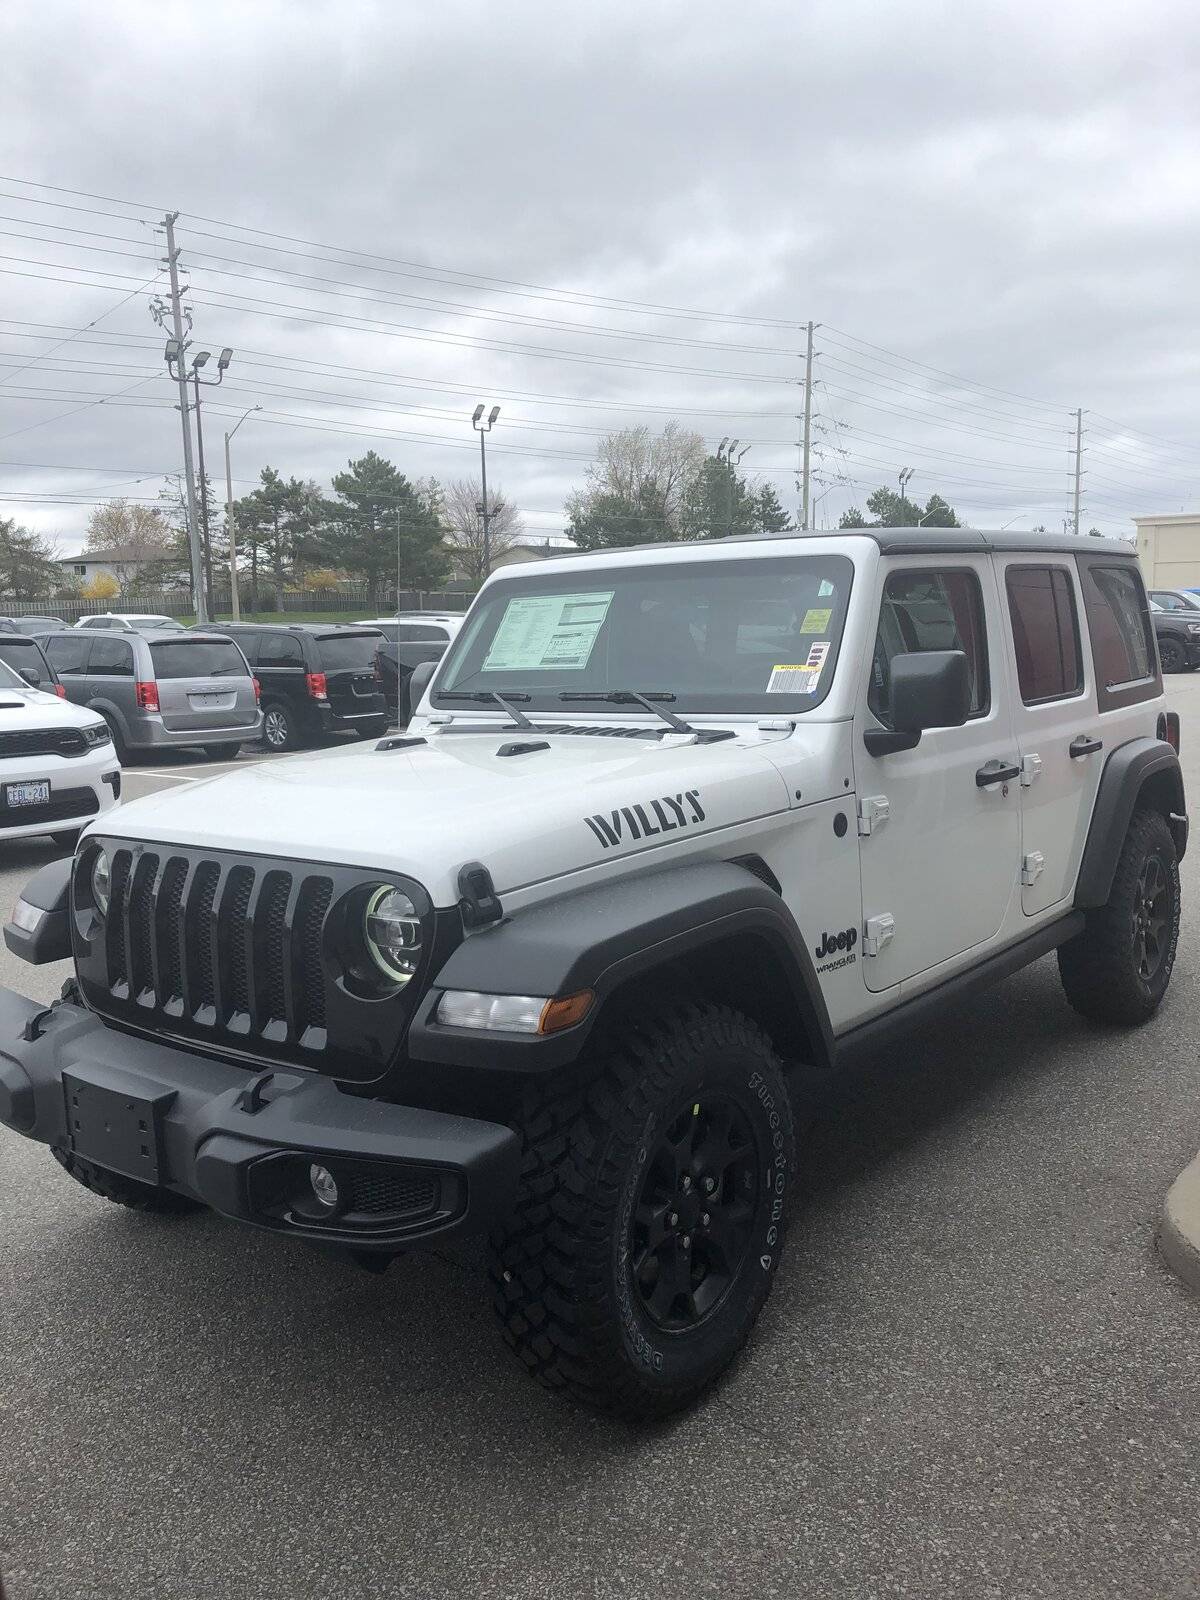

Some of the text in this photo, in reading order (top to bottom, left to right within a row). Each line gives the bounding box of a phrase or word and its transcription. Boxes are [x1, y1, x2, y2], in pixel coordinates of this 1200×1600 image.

[33, 787, 48, 798] 241
[583, 790, 705, 848] WILLYS
[815, 927, 857, 958] Jeep
[816, 953, 856, 973] WRANGLER
[748, 1072, 787, 1247] Firestone
